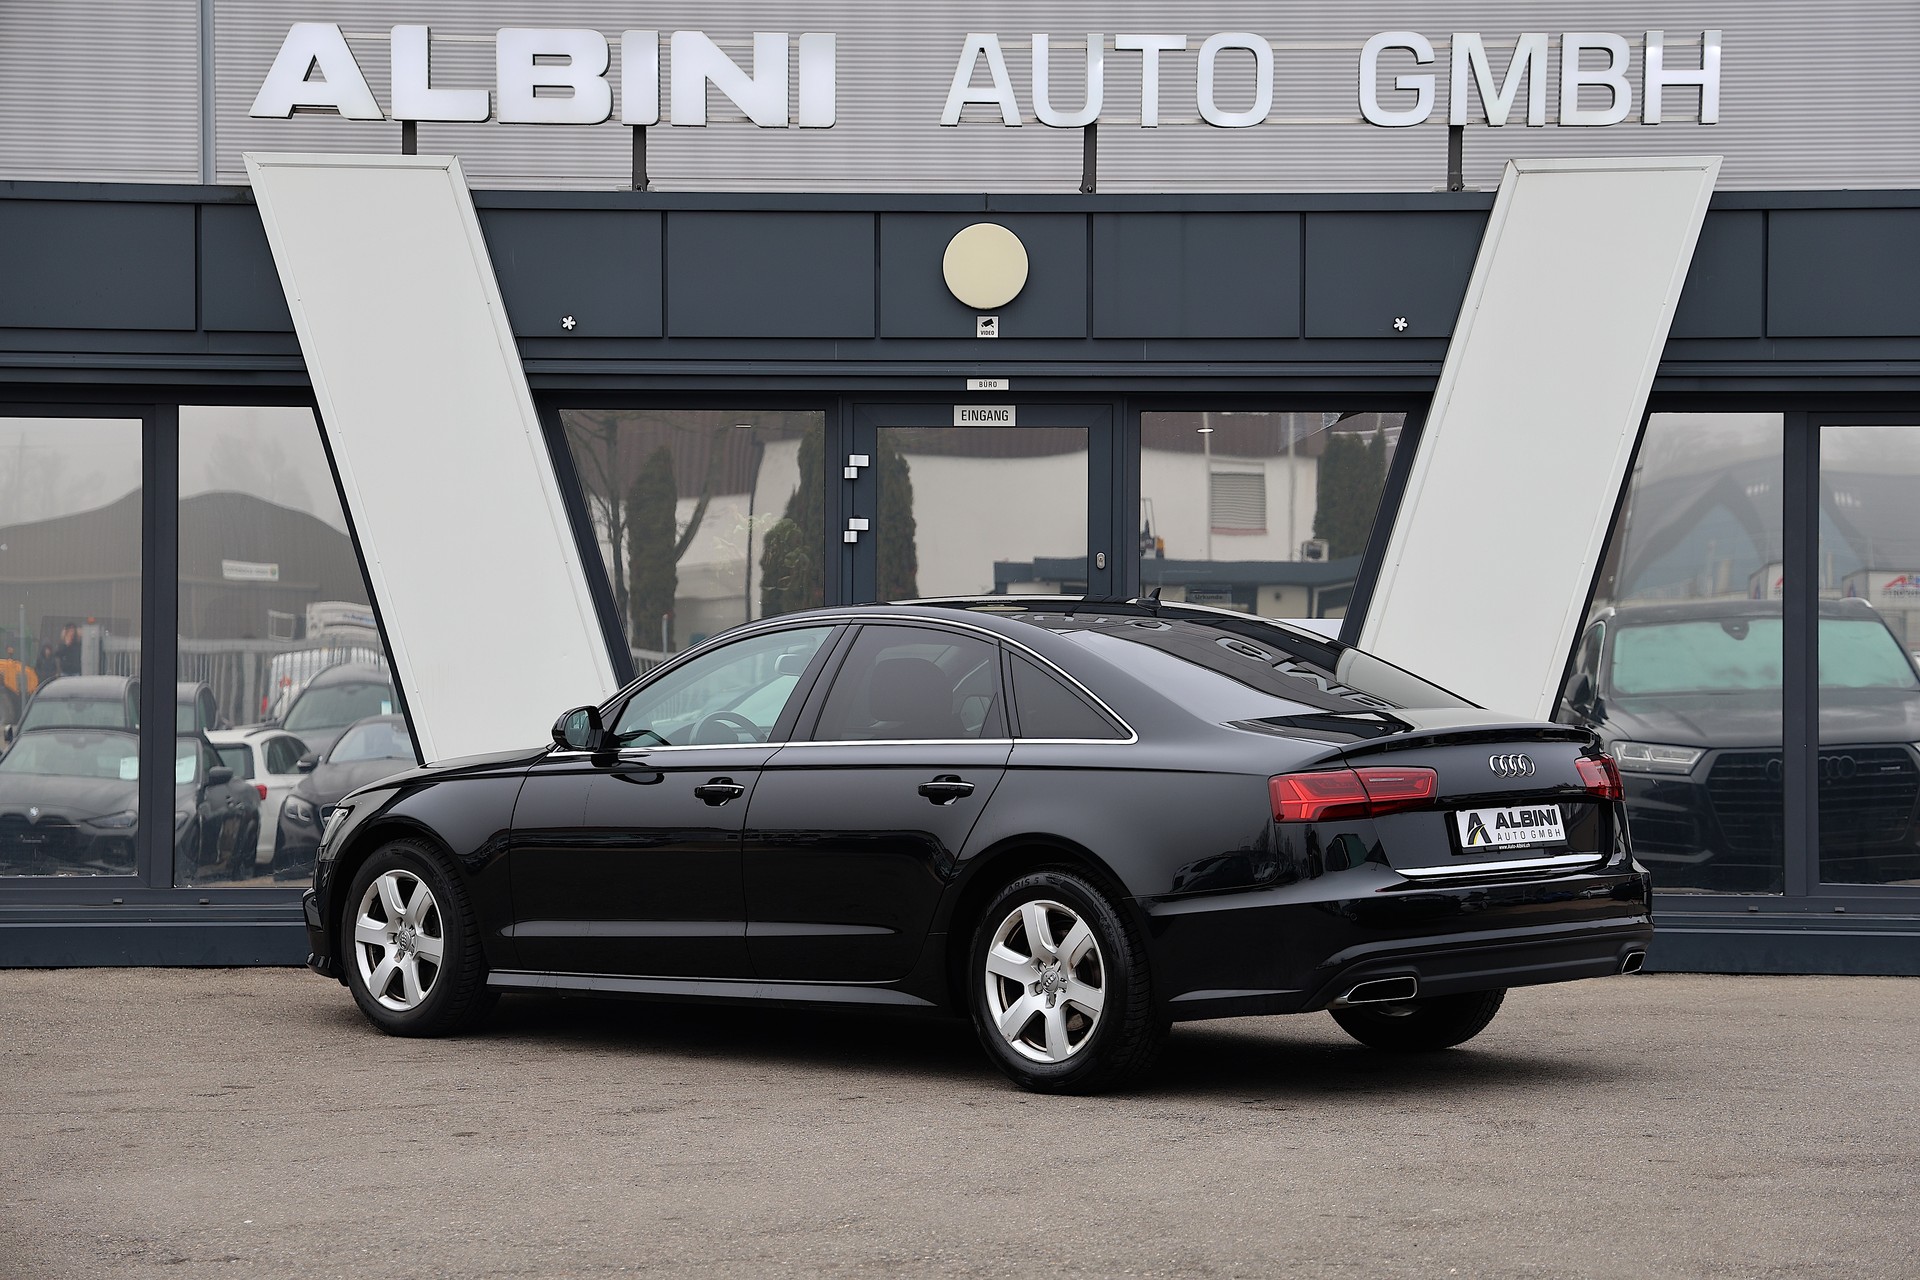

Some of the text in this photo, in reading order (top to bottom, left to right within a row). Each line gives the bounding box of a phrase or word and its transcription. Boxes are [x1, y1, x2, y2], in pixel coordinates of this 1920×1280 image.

[248, 22, 1723, 128] ALBINI AUTO GMBH
[978, 379, 998, 388] BÜRO
[961, 409, 1009, 422] EINGANG
[1495, 808, 1559, 830] ALBINI
[1497, 828, 1561, 842] AUTO GMBH
